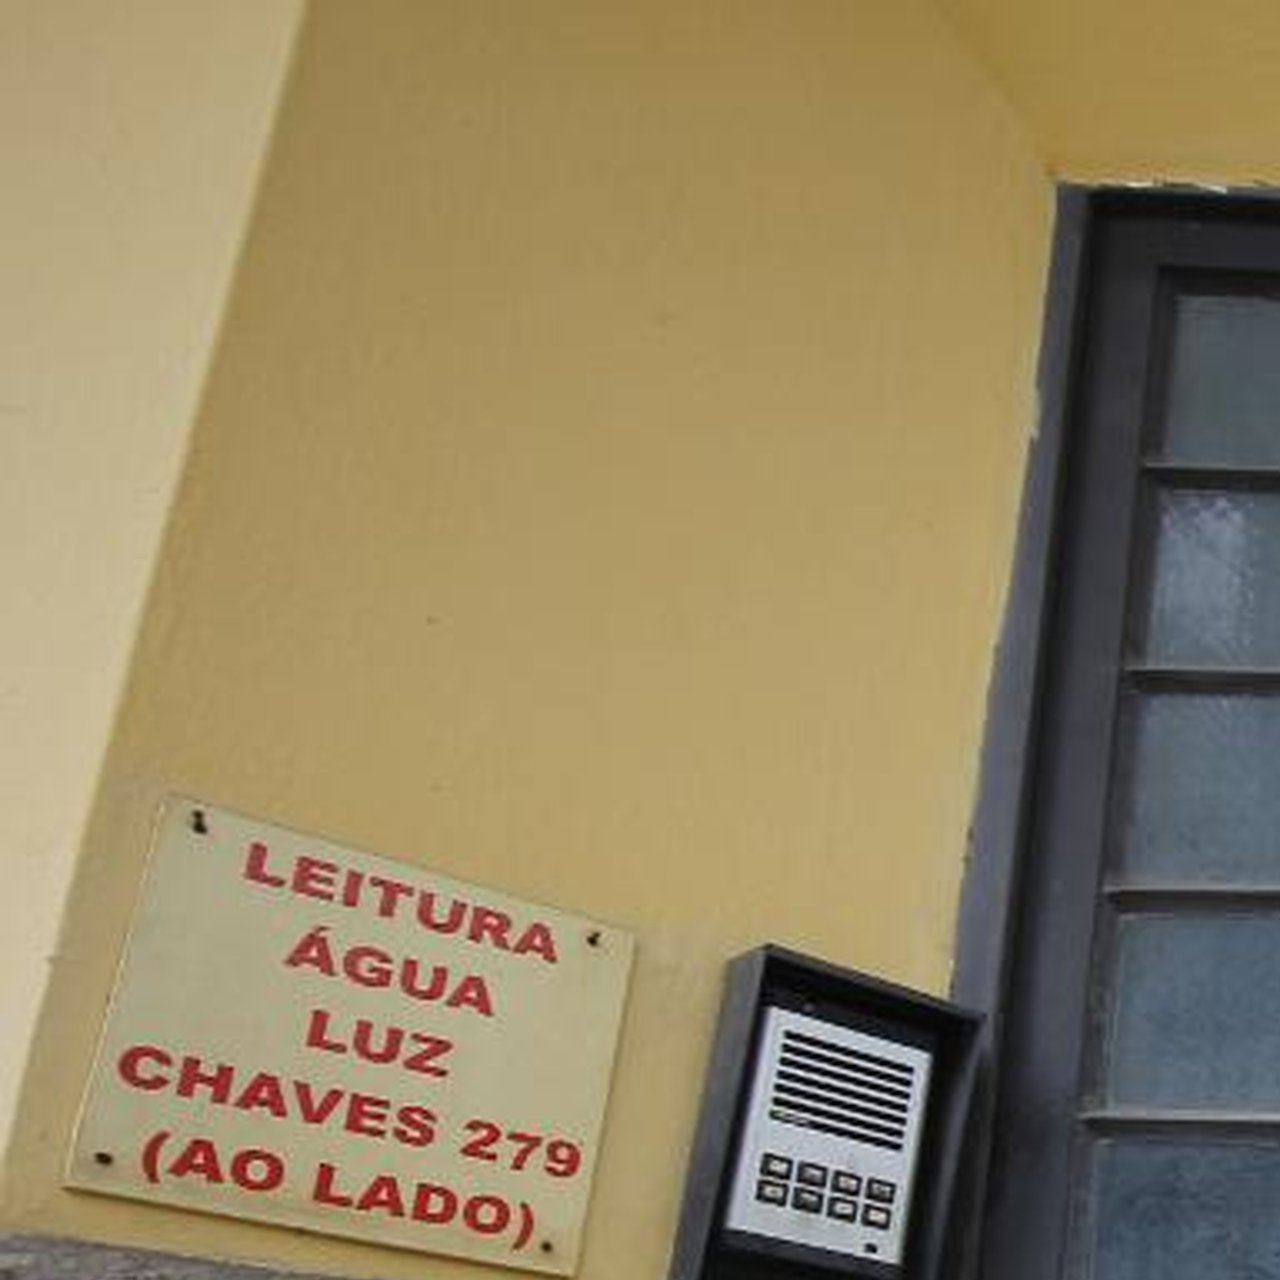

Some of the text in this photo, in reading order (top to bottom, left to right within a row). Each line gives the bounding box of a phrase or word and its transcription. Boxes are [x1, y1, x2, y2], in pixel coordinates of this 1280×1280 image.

[243, 842, 559, 963] LEITURA
[284, 925, 495, 1017] ÁGUA
[305, 1009, 454, 1078] LUZ
[117, 1045, 581, 1178] CHAVES 279
[141, 1130, 535, 1250] (AO LADO)
